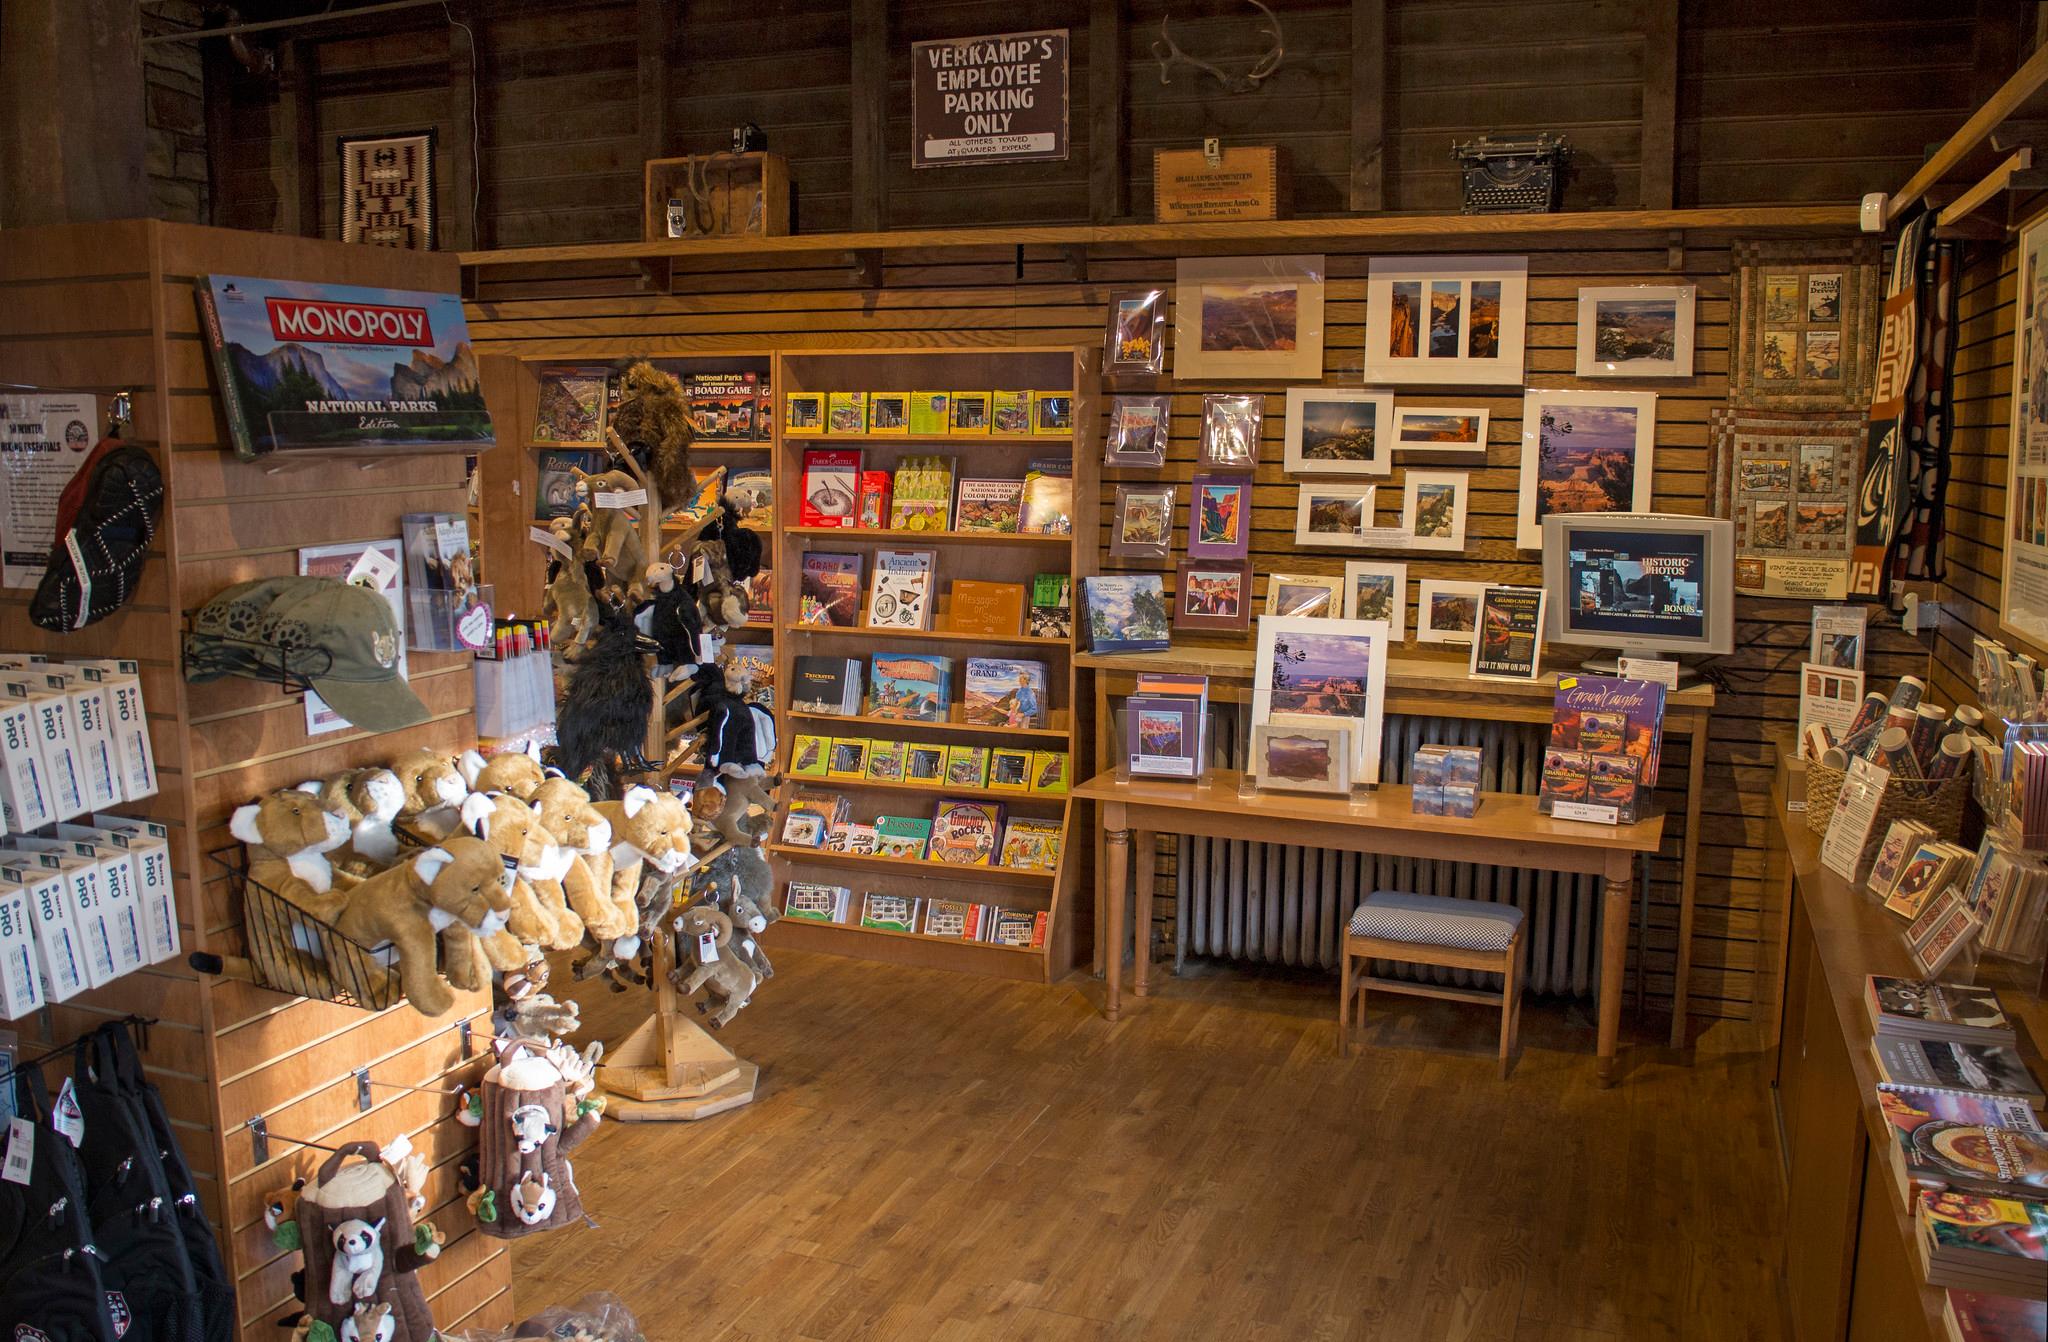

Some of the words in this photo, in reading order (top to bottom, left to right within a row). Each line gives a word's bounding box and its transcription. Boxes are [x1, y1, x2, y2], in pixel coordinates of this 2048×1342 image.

[928, 38, 1052, 68] VERKAMP'S
[936, 63, 1040, 91] EMPLOYEE
[944, 88, 1034, 114] PARKING
[964, 113, 1012, 135] ONLY
[276, 304, 424, 340] MONOPOLY
[306, 400, 386, 413] NATIONAL
[391, 400, 438, 413] PARKS
[359, 416, 400, 430] Edition
[24, 442, 61, 452] ESSENTIALS
[808, 559, 839, 571] GRAND
[888, 557, 918, 567] Ancient
[888, 566, 917, 576] Indians
[1642, 558, 1689, 567] HISTORIC
[1646, 567, 1685, 575] PHOTOS
[958, 593, 999, 608] Messages
[1664, 604, 1694, 613] BONUS
[982, 613, 1006, 624] Stone
[742, 656, 748, 668] &
[751, 656, 774, 678] Soap
[117, 689, 129, 721] PRO
[1567, 685, 1606, 704] Grand
[42, 708, 56, 740] PRO
[80, 699, 93, 731] PRO
[4, 716, 19, 750] PRO
[951, 826, 986, 840] ROCKS!
[1012, 823, 1031, 832] Magic
[1032, 824, 1055, 833] School
[108, 867, 120, 898] PRO
[145, 856, 156, 887] PRO
[76, 877, 90, 908] PRO
[39, 888, 54, 921] PRO
[0, 904, 13, 937] PRO
[2009, 1106, 2024, 1122] GRAND
[1983, 1126, 2000, 1146] Slow
[1991, 1146, 2013, 1182] Cooking
[2003, 1134, 2026, 1176] Southwest
